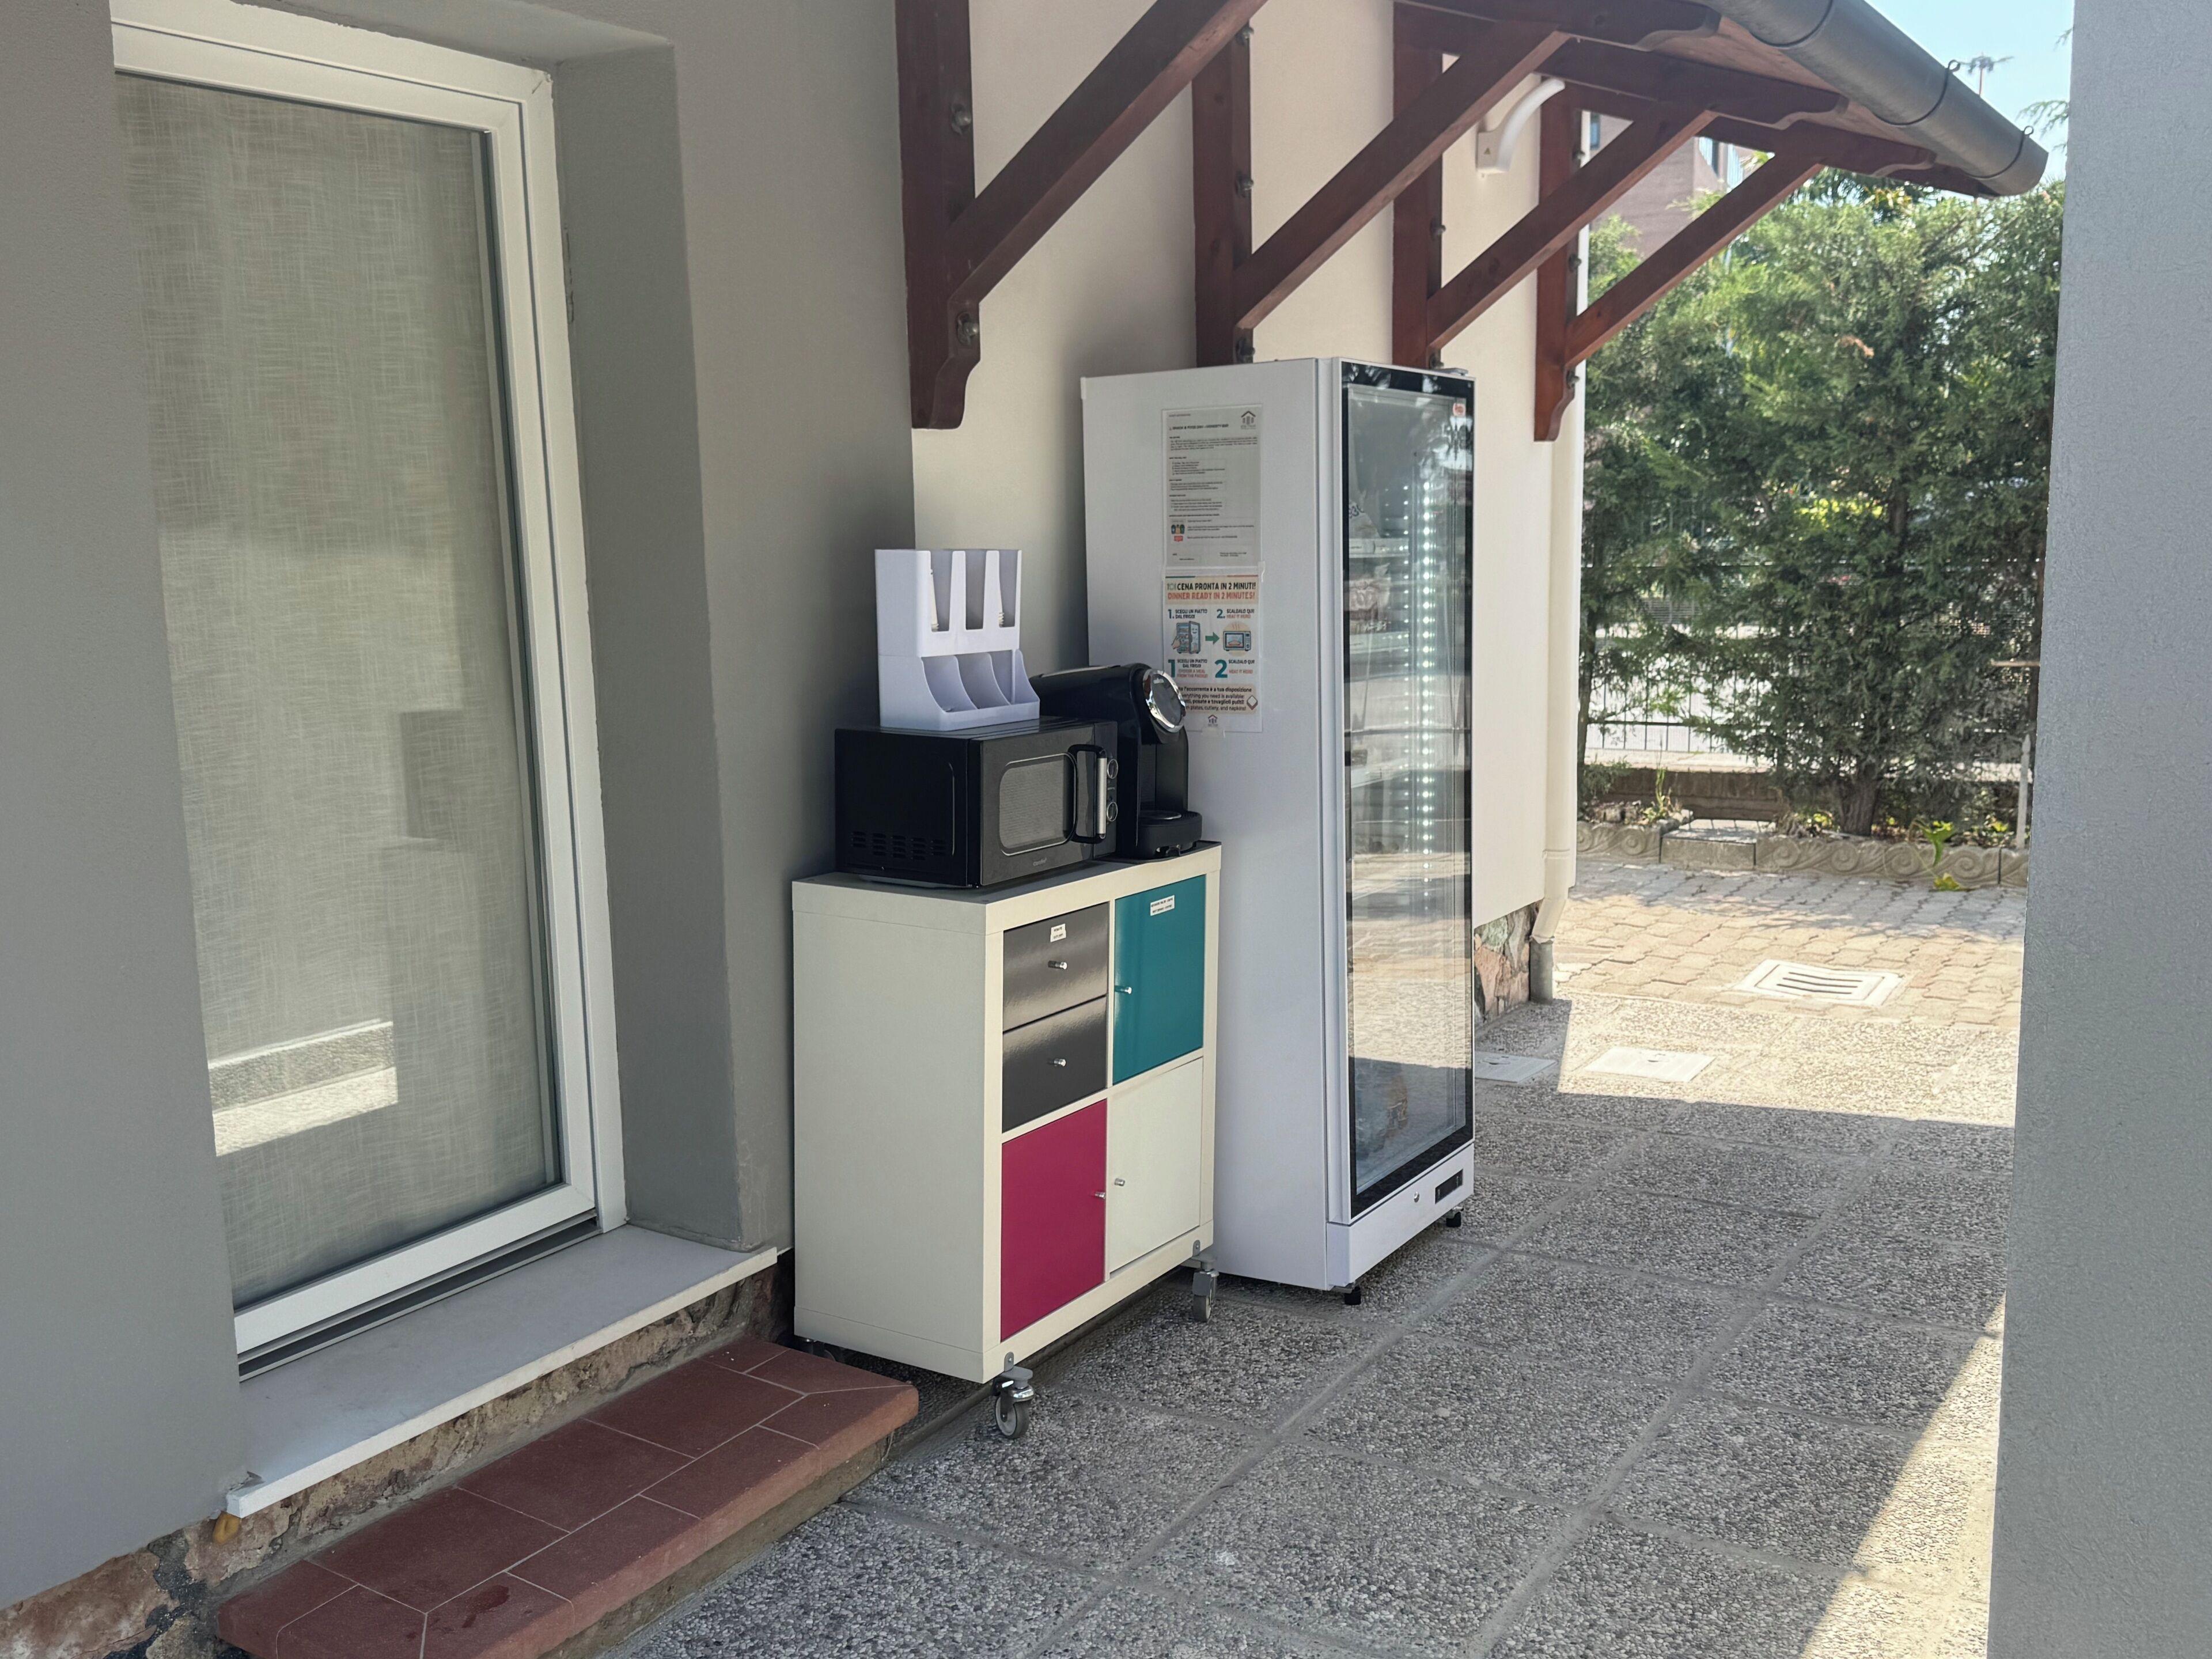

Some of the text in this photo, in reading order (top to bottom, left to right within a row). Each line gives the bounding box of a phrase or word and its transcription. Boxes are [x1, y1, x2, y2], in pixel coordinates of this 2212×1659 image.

[1177, 582, 1256, 590] CENA PRONTA IN 2 MINUTI!
[1192, 592, 1213, 600] READY
[1226, 592, 1255, 600] MINUTES!
[1168, 609, 1175, 619] 1.
[1217, 609, 1226, 619] 2.
[1168, 659, 1175, 678] 1
[1214, 659, 1228, 678] 2
